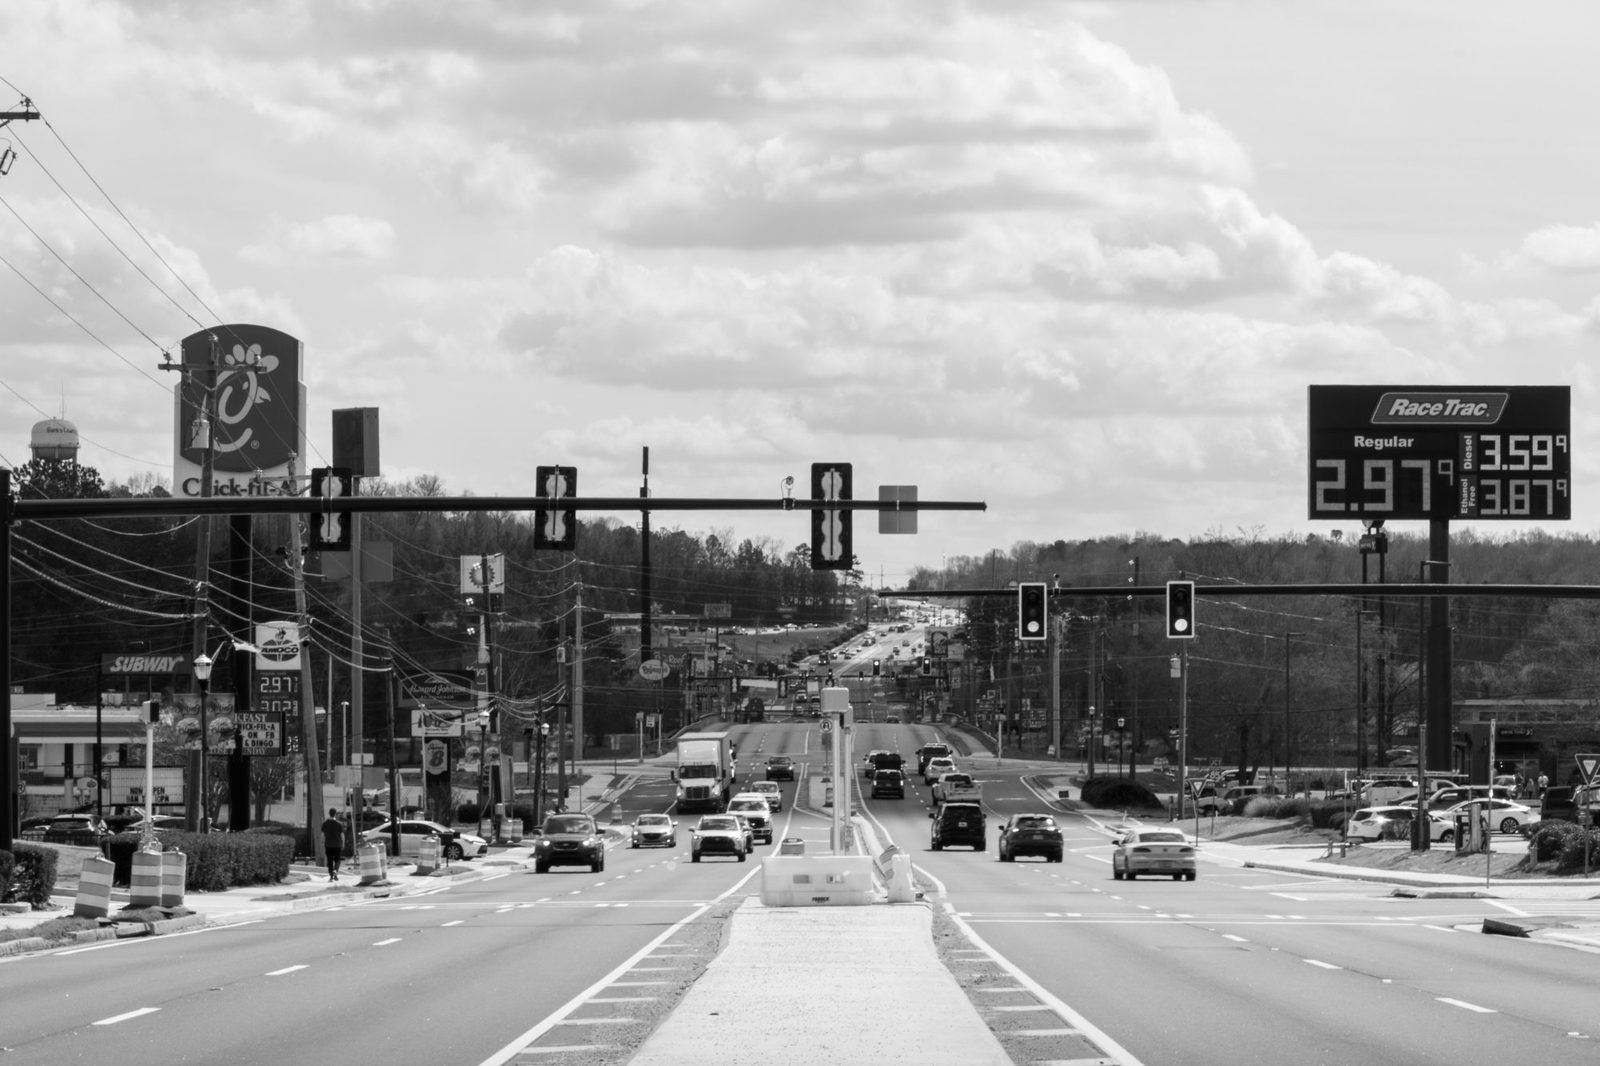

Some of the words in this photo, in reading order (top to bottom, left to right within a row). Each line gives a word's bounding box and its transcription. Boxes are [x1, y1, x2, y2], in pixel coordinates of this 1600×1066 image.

[1388, 398, 1487, 417] RaceTrac
[1354, 435, 1415, 450] Regular
[1464, 434, 1473, 470] Diesel
[1480, 435, 1553, 471] 3.59
[182, 477, 296, 497] Cick-fil-A
[1316, 460, 1430, 511] 2.97
[1461, 479, 1469, 514] Ethanol
[1468, 486, 1477, 507] Free
[1480, 479, 1553, 515] 3.87
[110, 656, 184, 672] SUBWAY
[430, 751, 444, 767] 8
